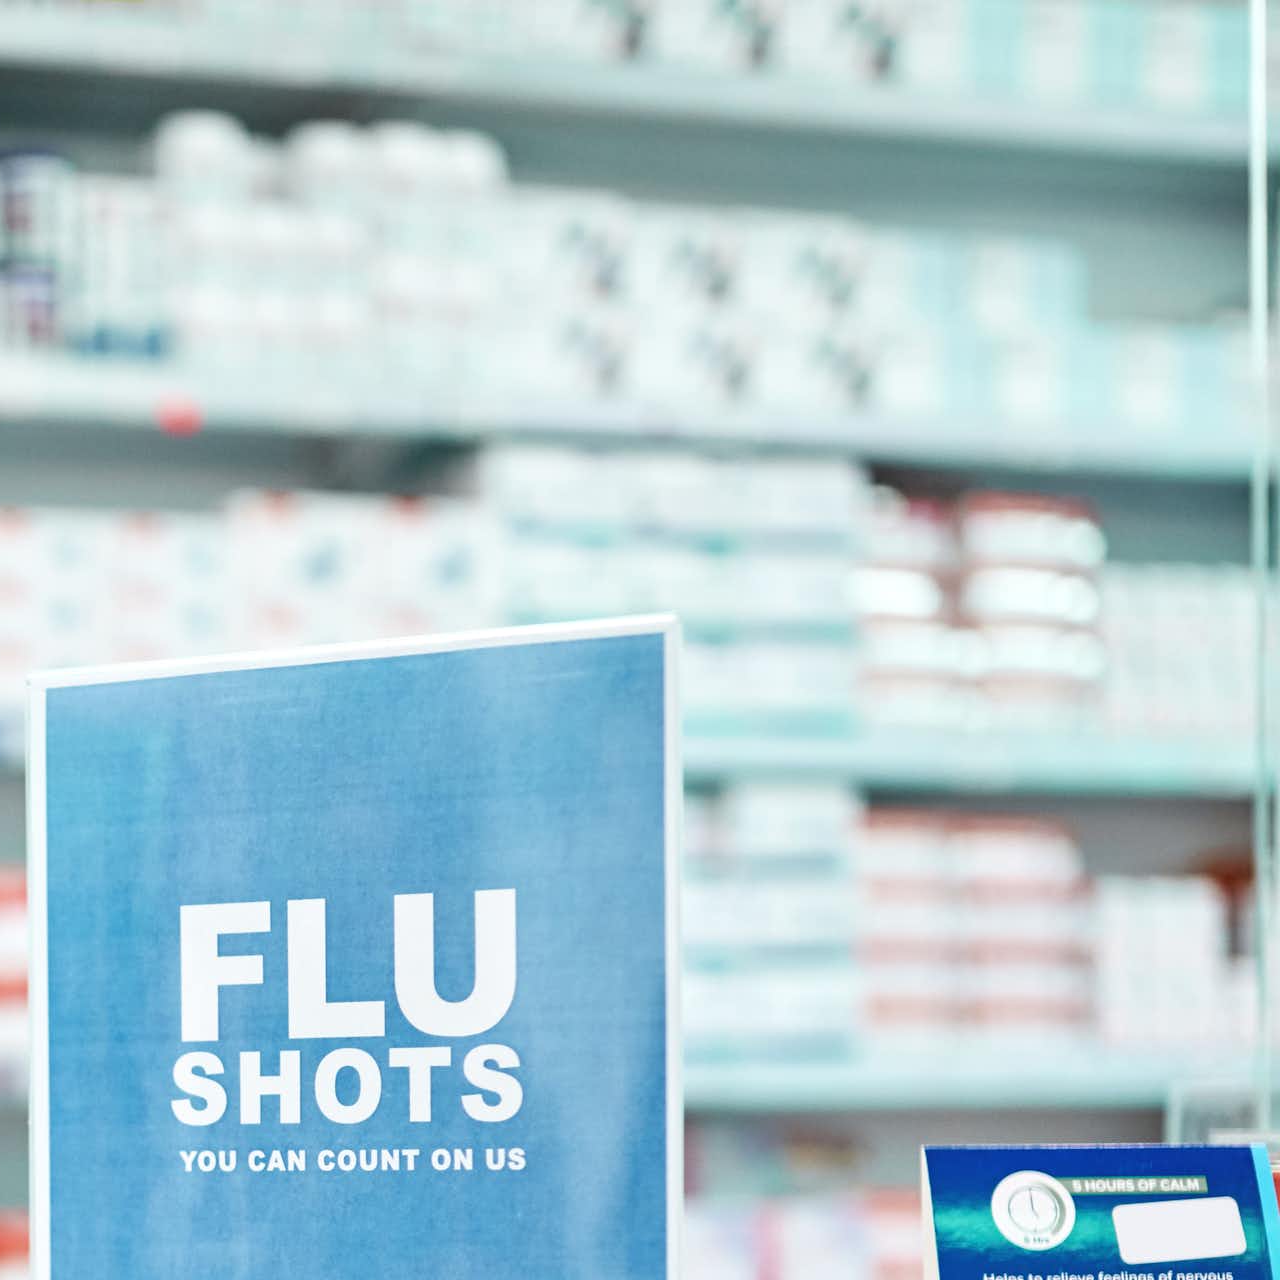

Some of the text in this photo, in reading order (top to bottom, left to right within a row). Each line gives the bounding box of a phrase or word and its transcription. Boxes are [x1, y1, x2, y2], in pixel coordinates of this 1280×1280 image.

[180, 888, 517, 1042] FLU
[171, 1044, 523, 1126] SHOTS
[180, 1147, 526, 1172] YOU CAN COUNT ON US
[1073, 1179, 1199, 1192] 5 HOURS OF CALM
